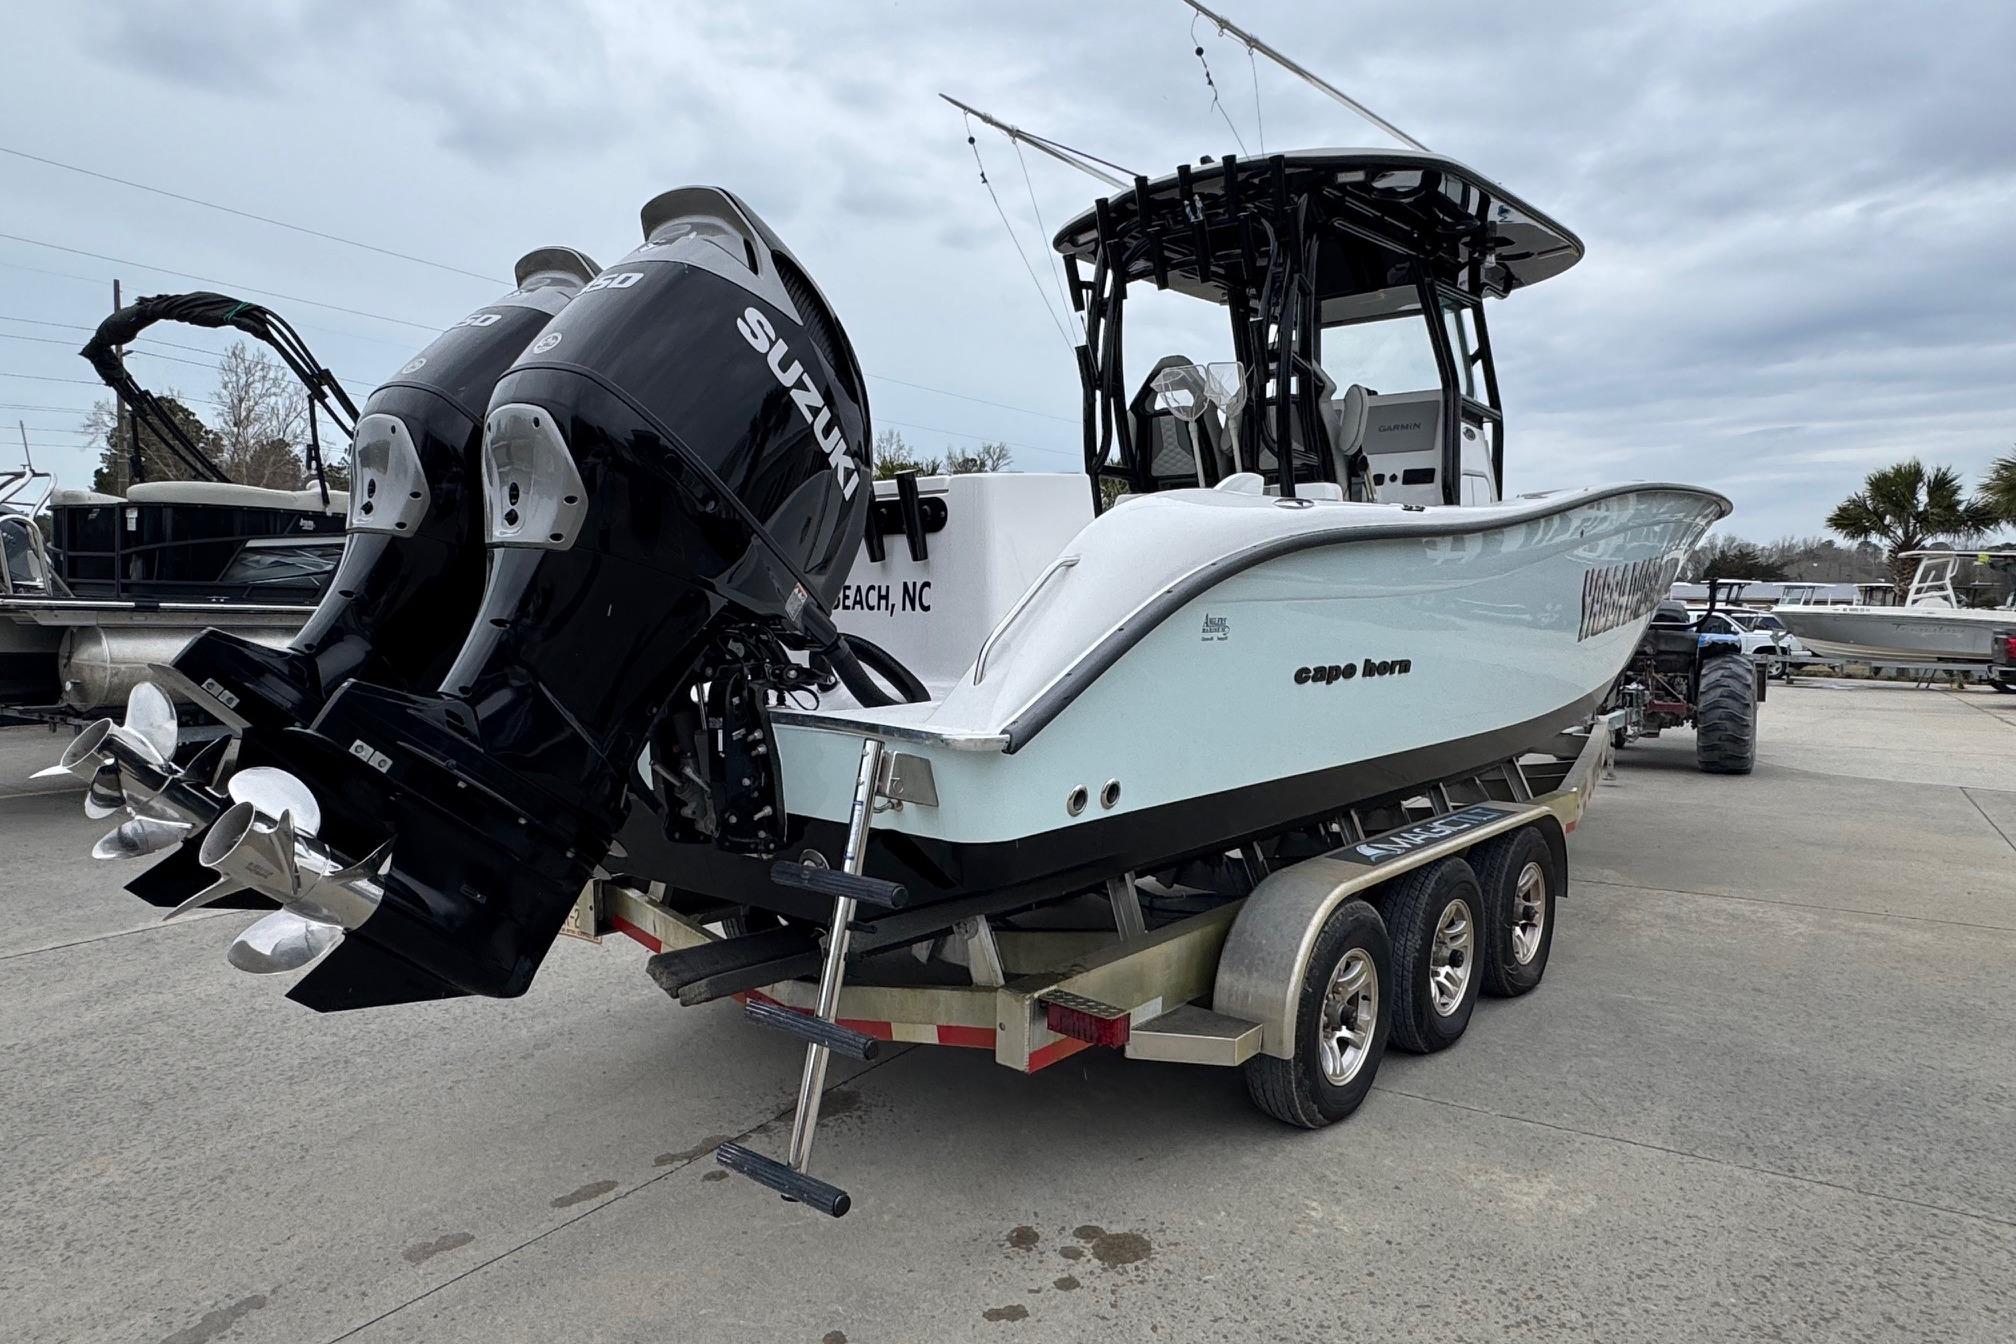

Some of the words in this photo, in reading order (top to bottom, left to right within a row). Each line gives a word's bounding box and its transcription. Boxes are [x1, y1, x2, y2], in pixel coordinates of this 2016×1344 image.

[581, 272, 644, 293] 50
[736, 307, 860, 501] SUZUKI
[1378, 422, 1422, 433] GARMIN
[901, 581, 932, 612] NC
[1294, 663, 1357, 685] cape
[1362, 659, 1412, 677] horn
